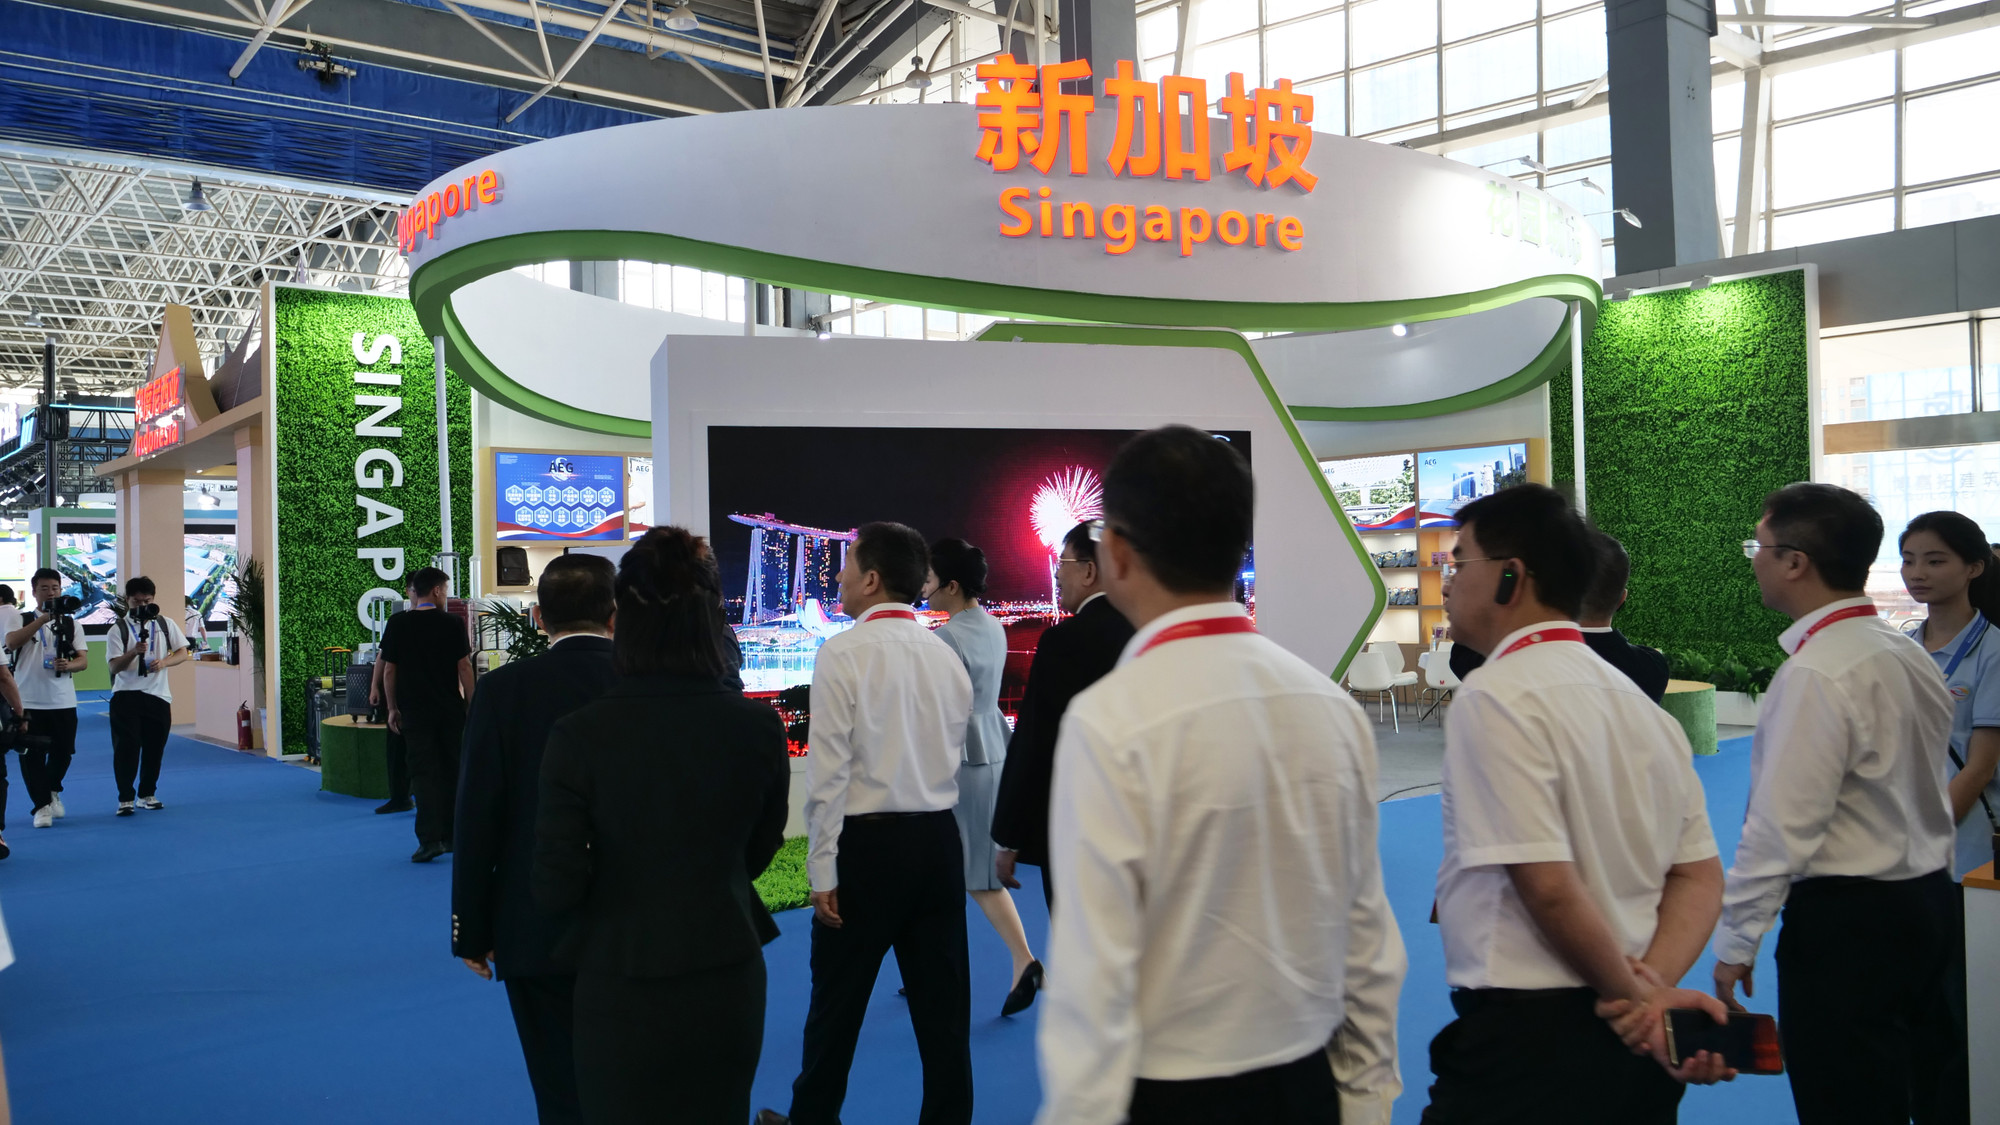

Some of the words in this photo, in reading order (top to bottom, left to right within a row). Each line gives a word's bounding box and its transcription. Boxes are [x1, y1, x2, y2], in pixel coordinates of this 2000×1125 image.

[975, 53, 1318, 193] 新加坡
[397, 169, 498, 256] ingapore
[998, 187, 1304, 256] Singapore
[352, 332, 405, 655] SINGAPO
[549, 462, 574, 473] AEG
